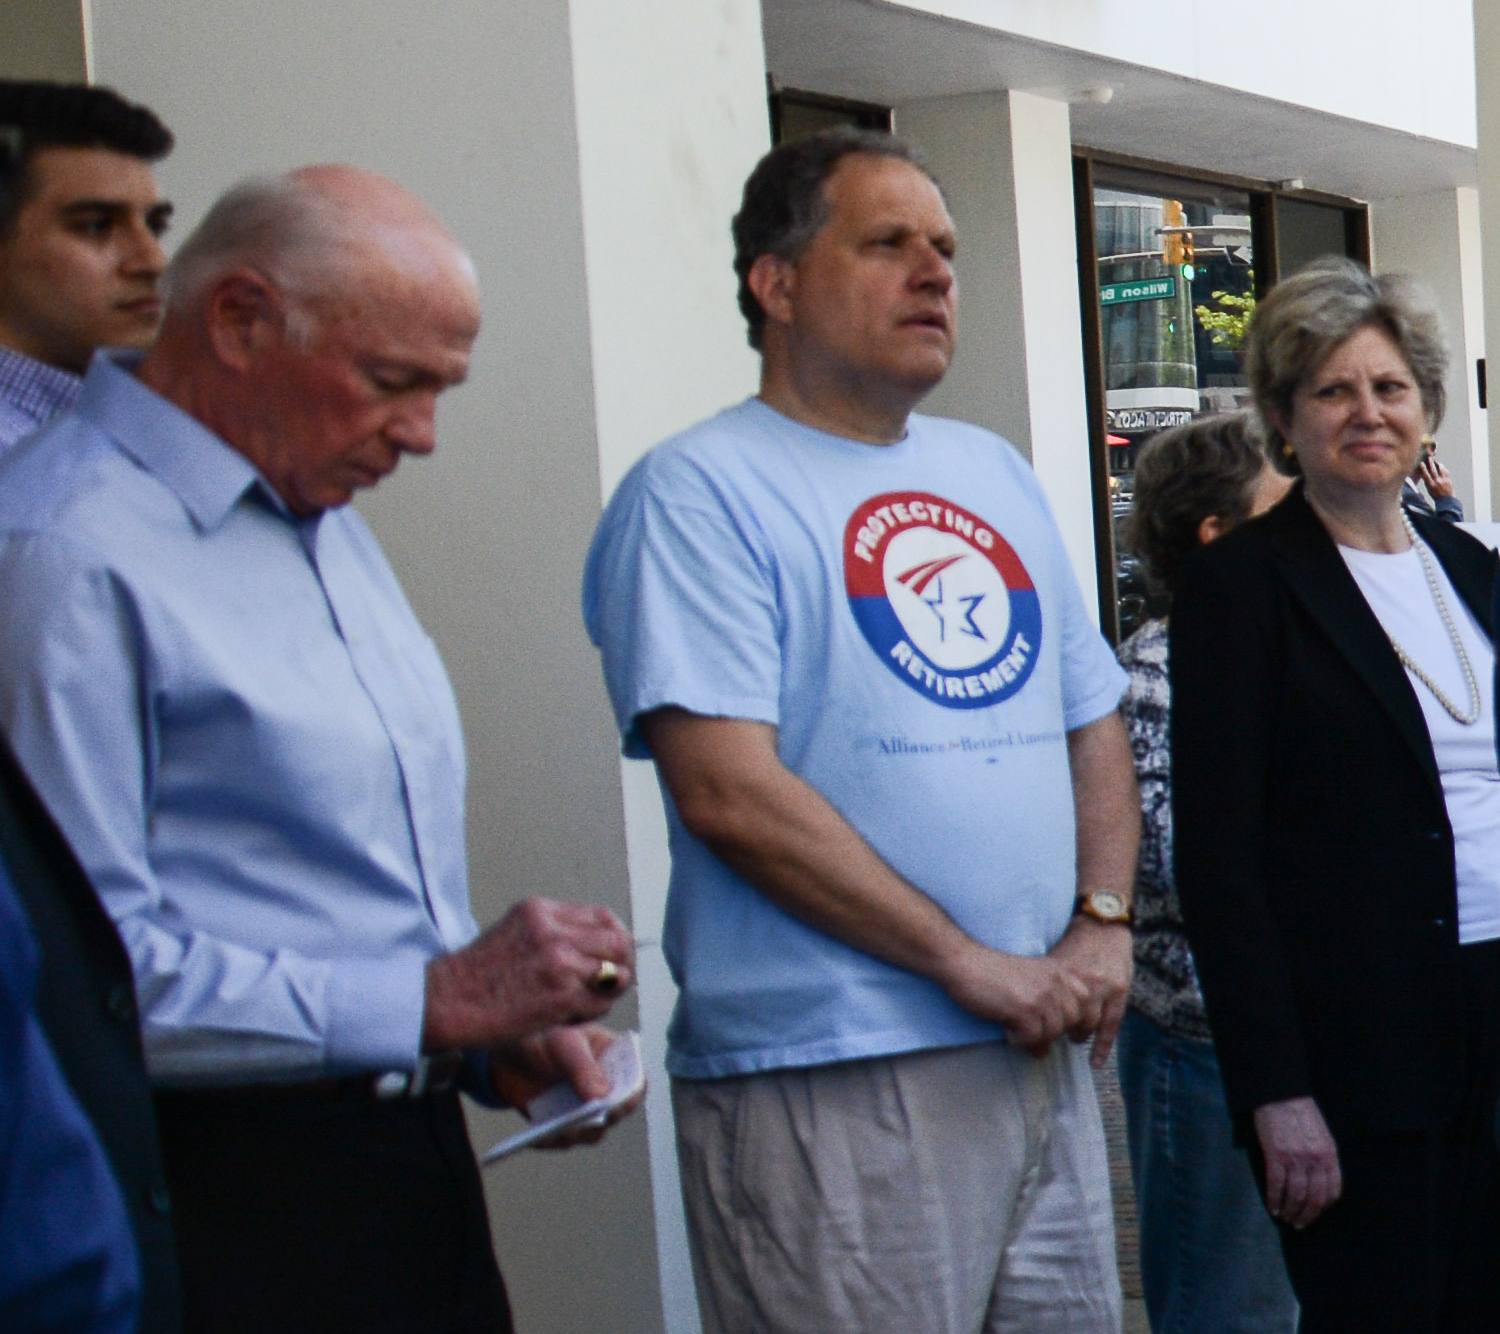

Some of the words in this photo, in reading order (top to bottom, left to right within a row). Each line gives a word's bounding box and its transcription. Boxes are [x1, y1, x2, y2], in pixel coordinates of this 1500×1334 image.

[854, 500, 995, 564] PROTECTING
[889, 631, 1032, 700] RETIREMENT
[876, 735, 947, 755] Alliance
